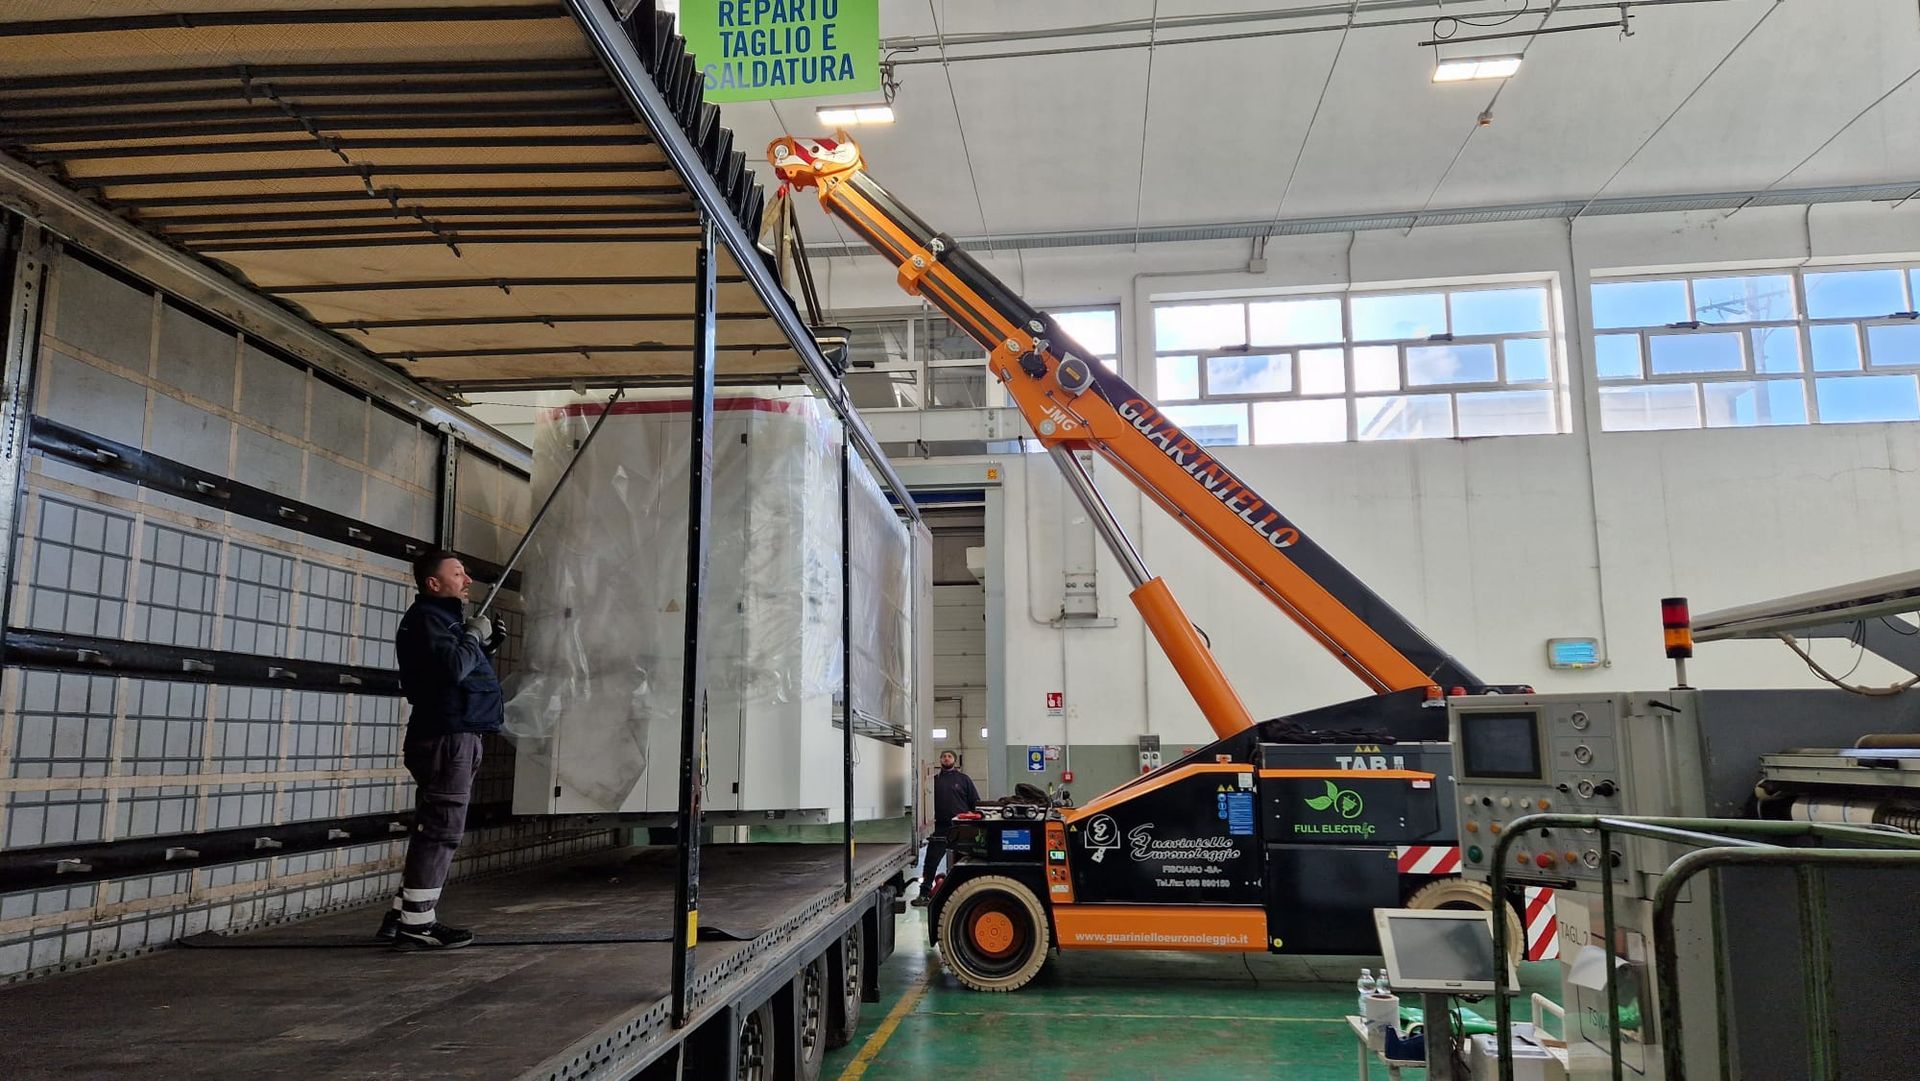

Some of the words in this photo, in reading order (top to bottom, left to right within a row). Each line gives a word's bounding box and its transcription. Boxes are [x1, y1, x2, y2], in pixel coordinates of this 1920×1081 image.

[719, 0, 838, 27] REPARTO
[719, 25, 811, 58] TAGLIO
[823, 23, 837, 51] E
[703, 53, 855, 91] SALDATURA
[1040, 404, 1078, 431] JMG
[1118, 398, 1300, 549] GUARINIELLO
[1294, 824, 1320, 833] FULL
[1075, 932, 1248, 945] www.guarinielloeuronoleggio.it
